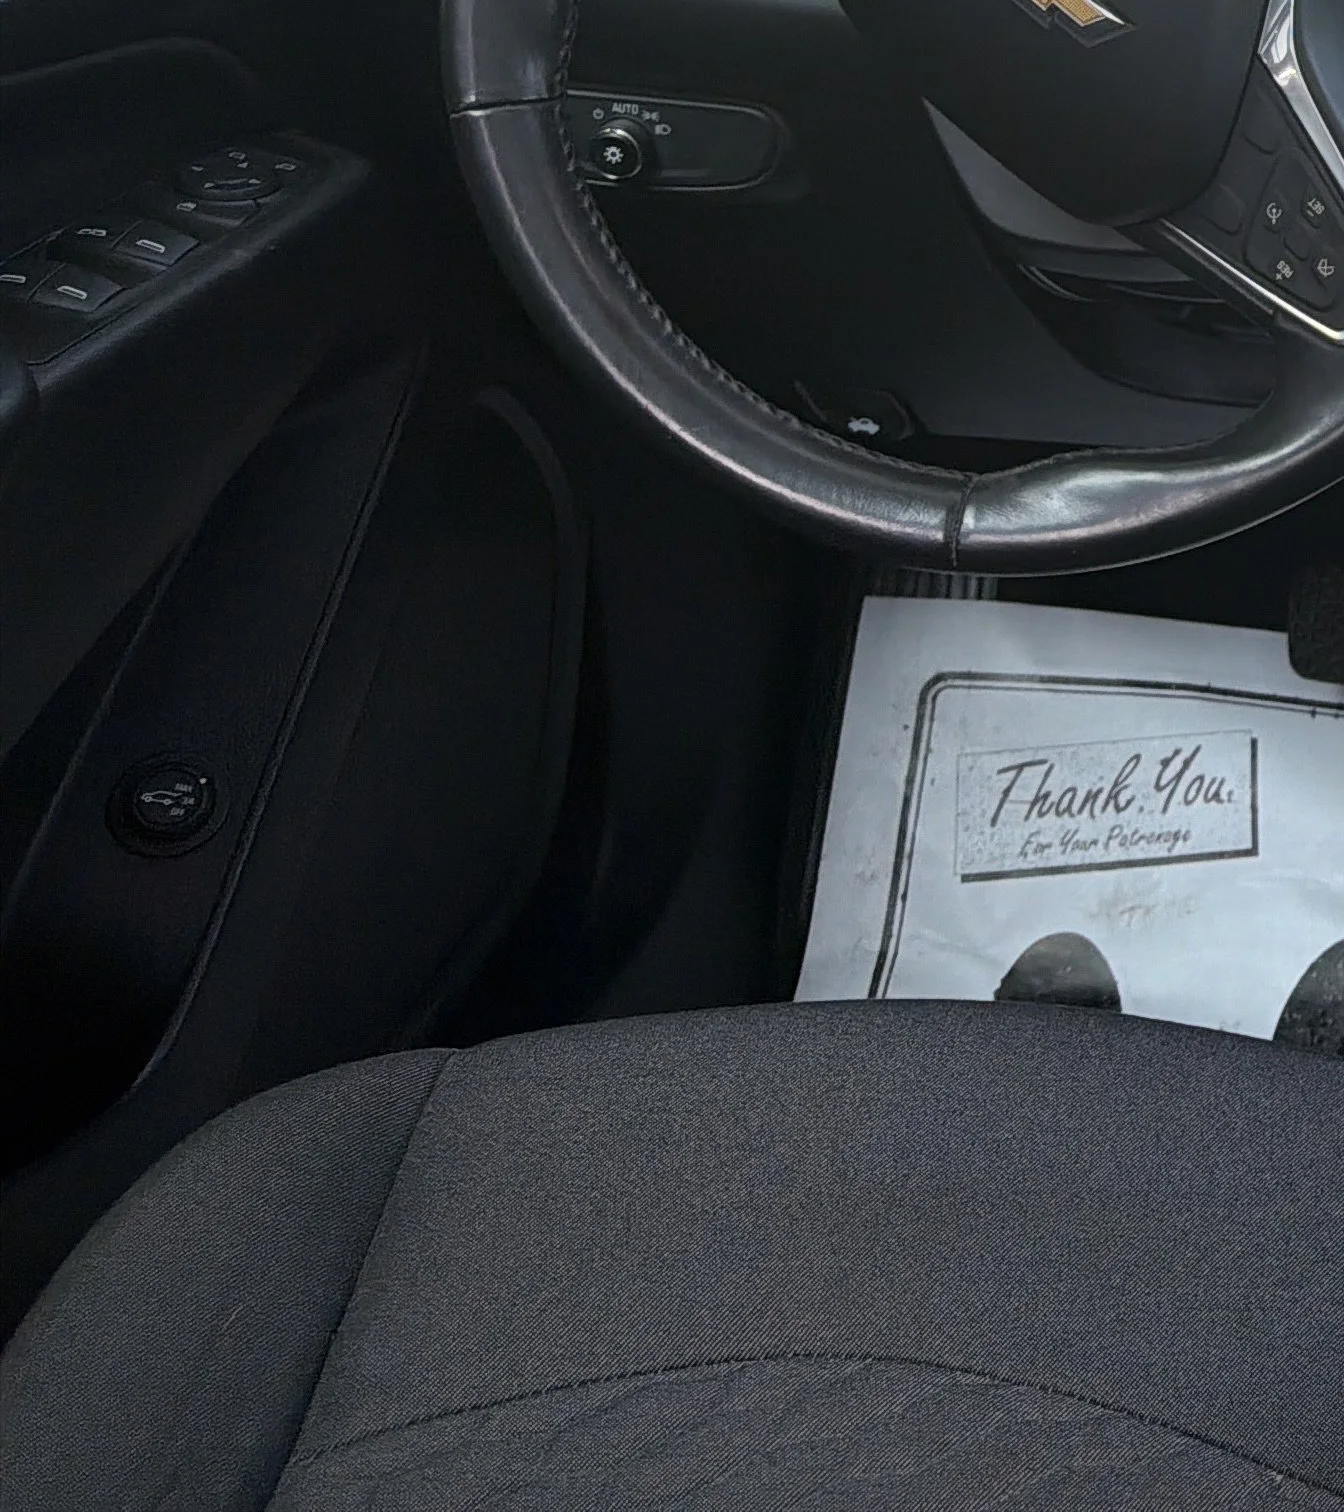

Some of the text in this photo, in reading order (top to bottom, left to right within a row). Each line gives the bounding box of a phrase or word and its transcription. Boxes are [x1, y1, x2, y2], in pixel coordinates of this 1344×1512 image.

[612, 102, 639, 115] AUTO
[1019, 830, 1054, 858] For
[1103, 824, 1192, 853] Patronage
